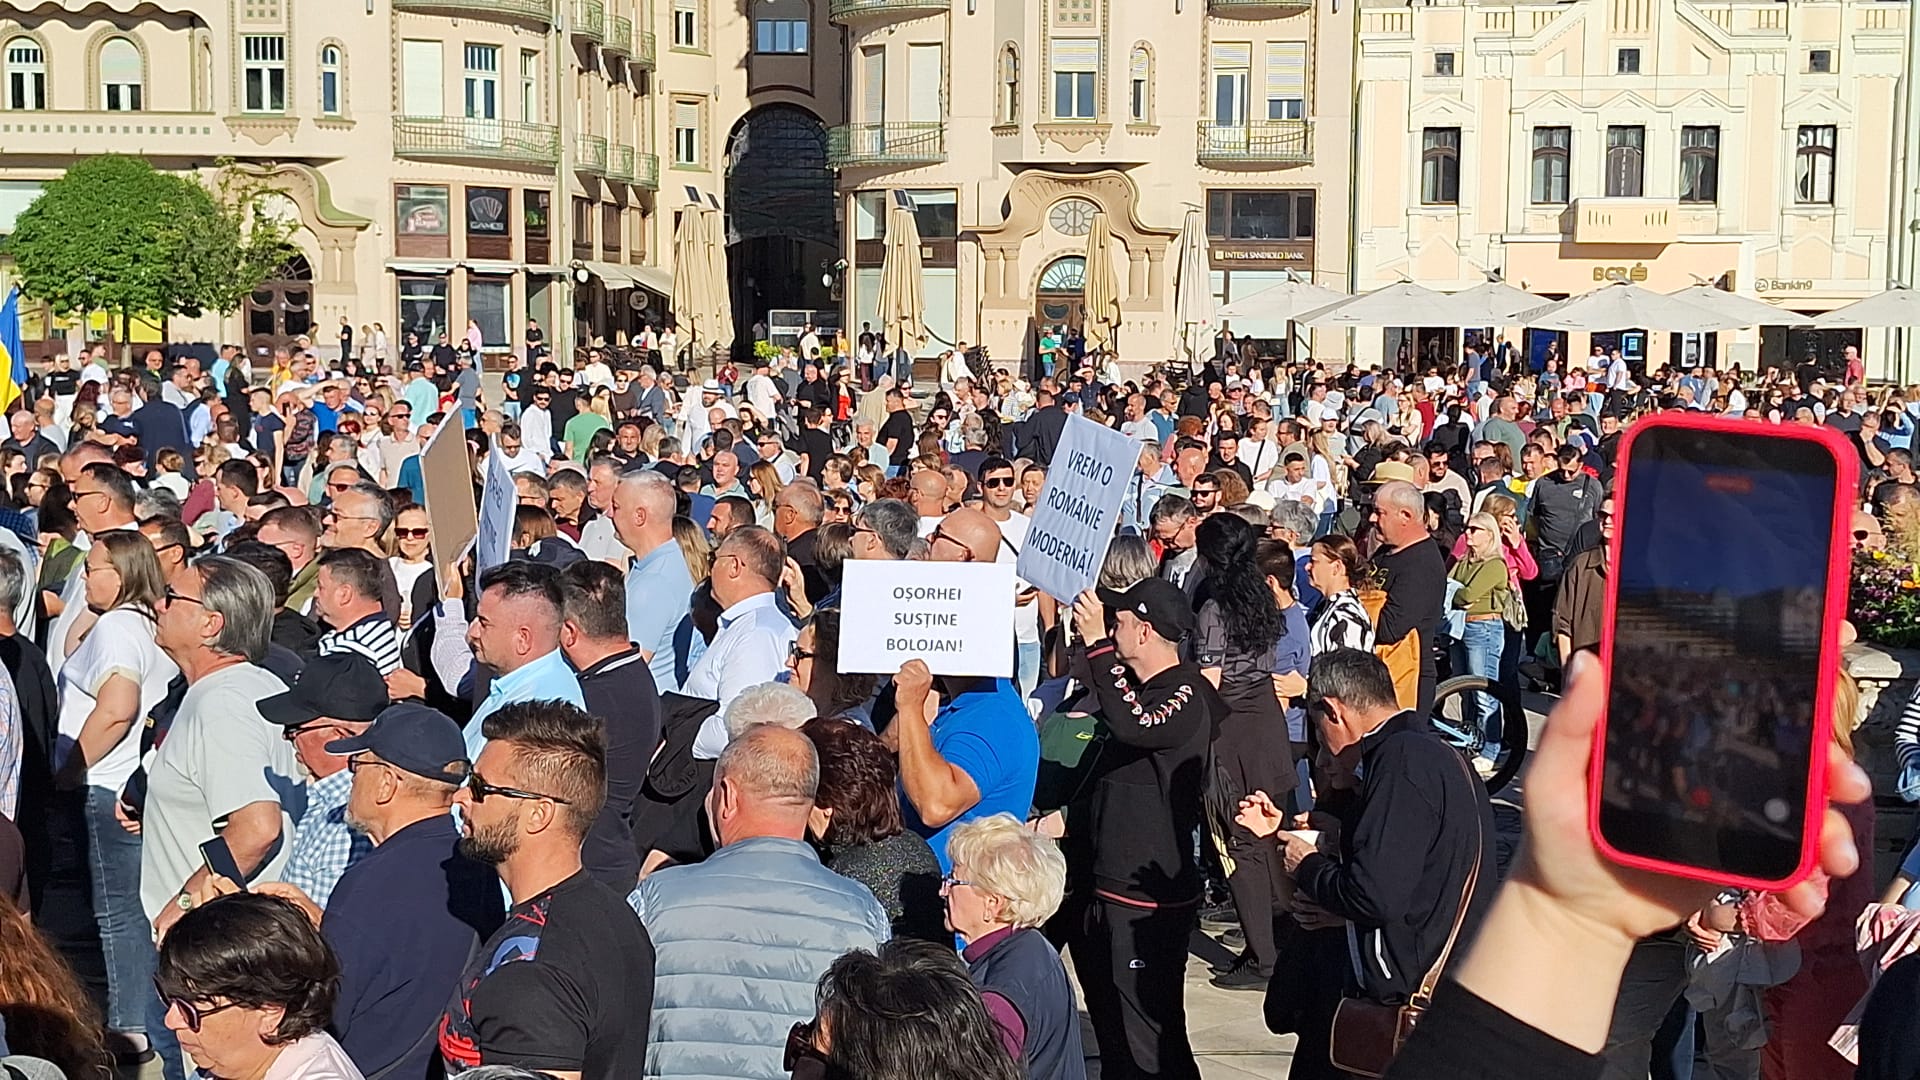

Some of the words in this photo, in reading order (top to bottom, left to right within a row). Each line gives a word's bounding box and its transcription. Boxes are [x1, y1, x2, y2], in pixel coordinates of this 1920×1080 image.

[1285, 251, 1304, 259] BANK
[1771, 280, 1812, 290] Banking
[1067, 449, 1102, 482] VREM
[1101, 465, 1113, 486] O
[1047, 486, 1104, 531] ROMÂNIE
[1028, 526, 1095, 577] MODERNĂ!
[893, 586, 961, 602] OȘORHEI
[894, 612, 958, 628] SUSȚINE
[886, 638, 963, 652] BOLOJAN!
